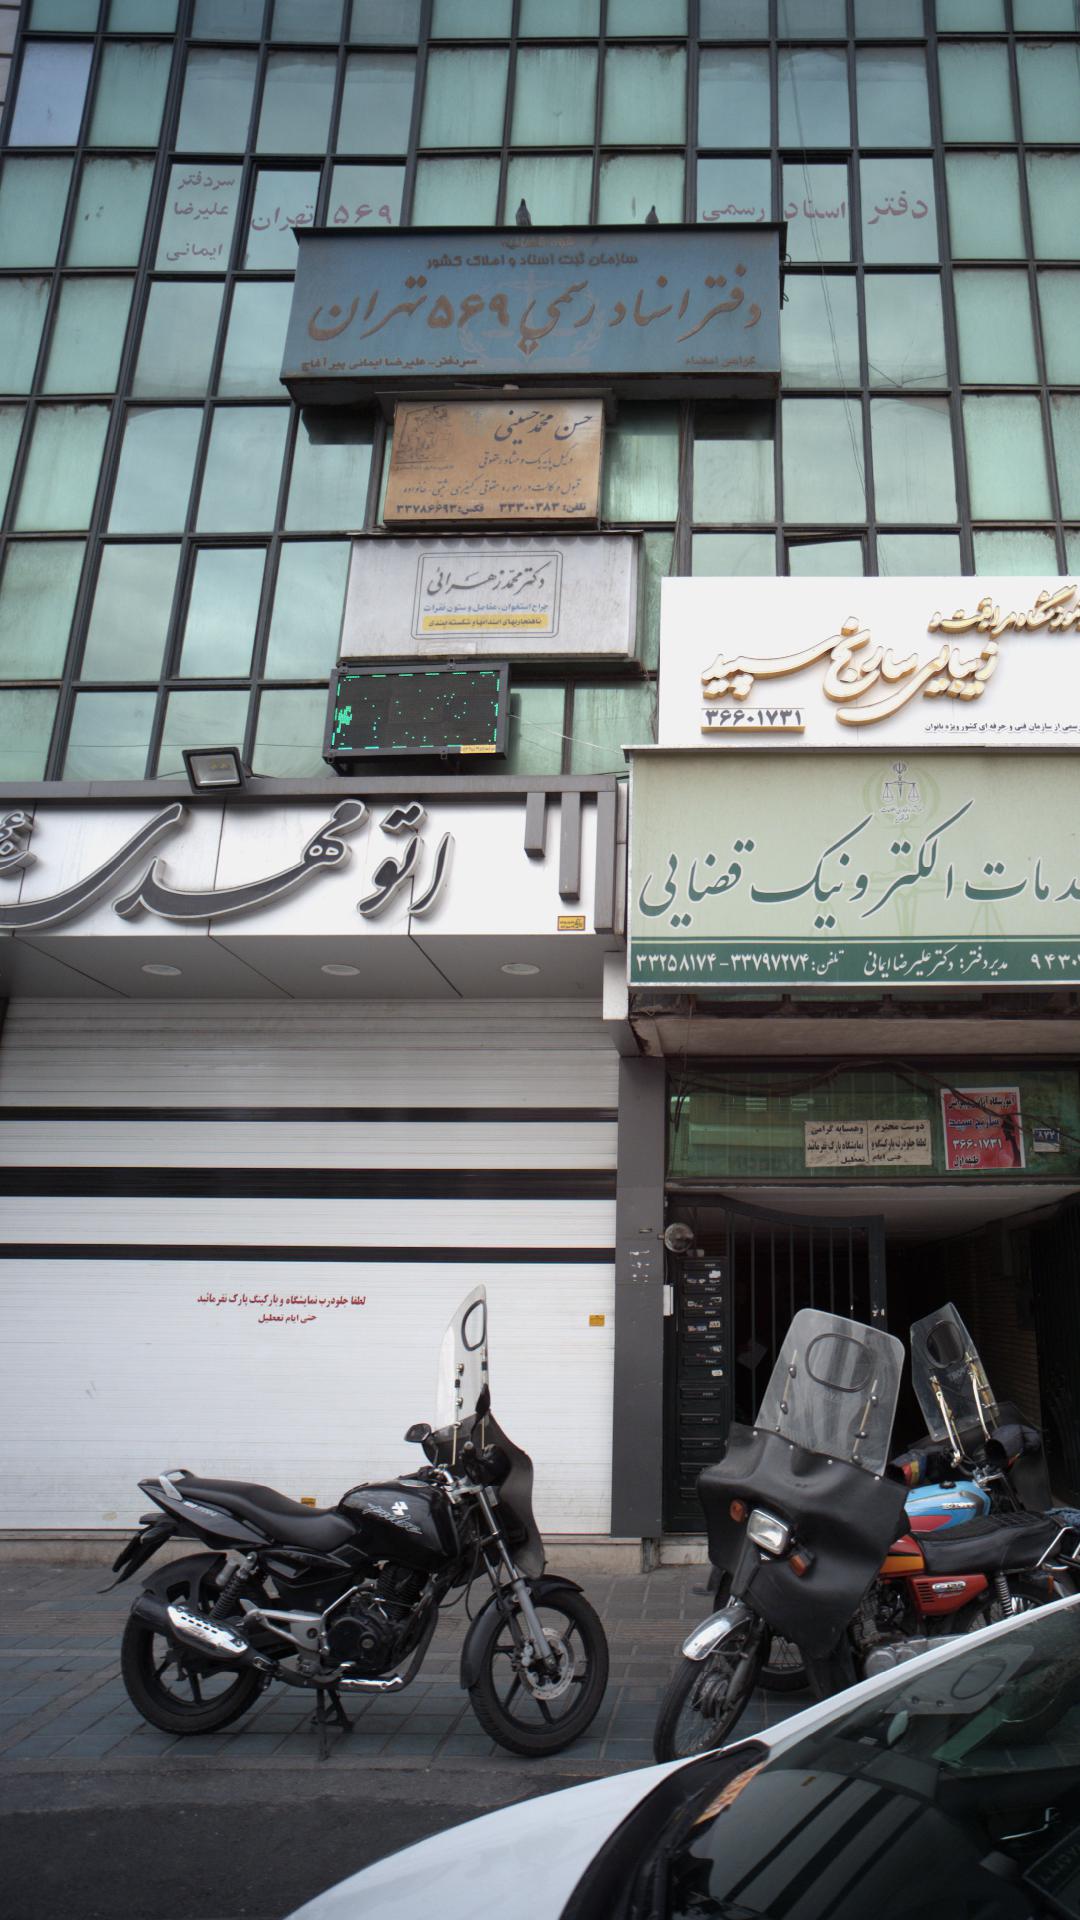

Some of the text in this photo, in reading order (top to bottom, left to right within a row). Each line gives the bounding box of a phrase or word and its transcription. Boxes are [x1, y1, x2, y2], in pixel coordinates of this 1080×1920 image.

[177, 171, 236, 190] سردفتر
[174, 202, 229, 220] علیرضا
[702, 203, 766, 222] رسمی
[784, 200, 846, 219] اسناد
[867, 190, 929, 224] دفتر
[251, 205, 314, 231] تهران
[166, 242, 223, 261] ایمانی
[466, 253, 504, 266] املاک
[519, 253, 554, 265] اسناد
[558, 251, 584, 265] ثبت
[588, 252, 638, 267] سازمان
[426, 253, 462, 269] کشور
[308, 263, 762, 356] دفتر اسناد رسمی ۵۶۹ تهران
[385, 357, 426, 369] علیرضا
[494, 409, 540, 445] حسینی
[554, 415, 593, 440] حسن
[562, 502, 587, 512] تلفن:
[502, 568, 523, 590] محمد
[512, 560, 552, 596] دکتر
[836, 641, 999, 727] زیبایی
[705, 708, 802, 726] ۳۶۶۰۱۷۳۱
[925, 723, 944, 732] بانوان
[961, 722, 978, 732] کشور
[989, 723, 1006, 732] حرفه
[1013, 722, 1027, 732] فنی
[1029, 722, 1052, 732] سازمان
[750, 799, 977, 932] الکترونیک
[638, 838, 756, 930] قضایی
[811, 949, 845, 976] تلفن:
[863, 951, 892, 979] ایمانی
[893, 948, 932, 977] علیرضا
[926, 944, 959, 978] دکتر
[989, 957, 1009, 977] مدیر
[875, 1123, 899, 1133] محترم
[901, 1123, 925, 1133] دوست
[952, 1138, 1003, 1150] ۳۶۶۰۱۷۳۱
[229, 1294, 249, 1307] پارک
[285, 1295, 318, 1307] نمایشگاه
[350, 1295, 367, 1306] لطفا
[258, 1313, 318, 1324] حتی ایام تعطیل
